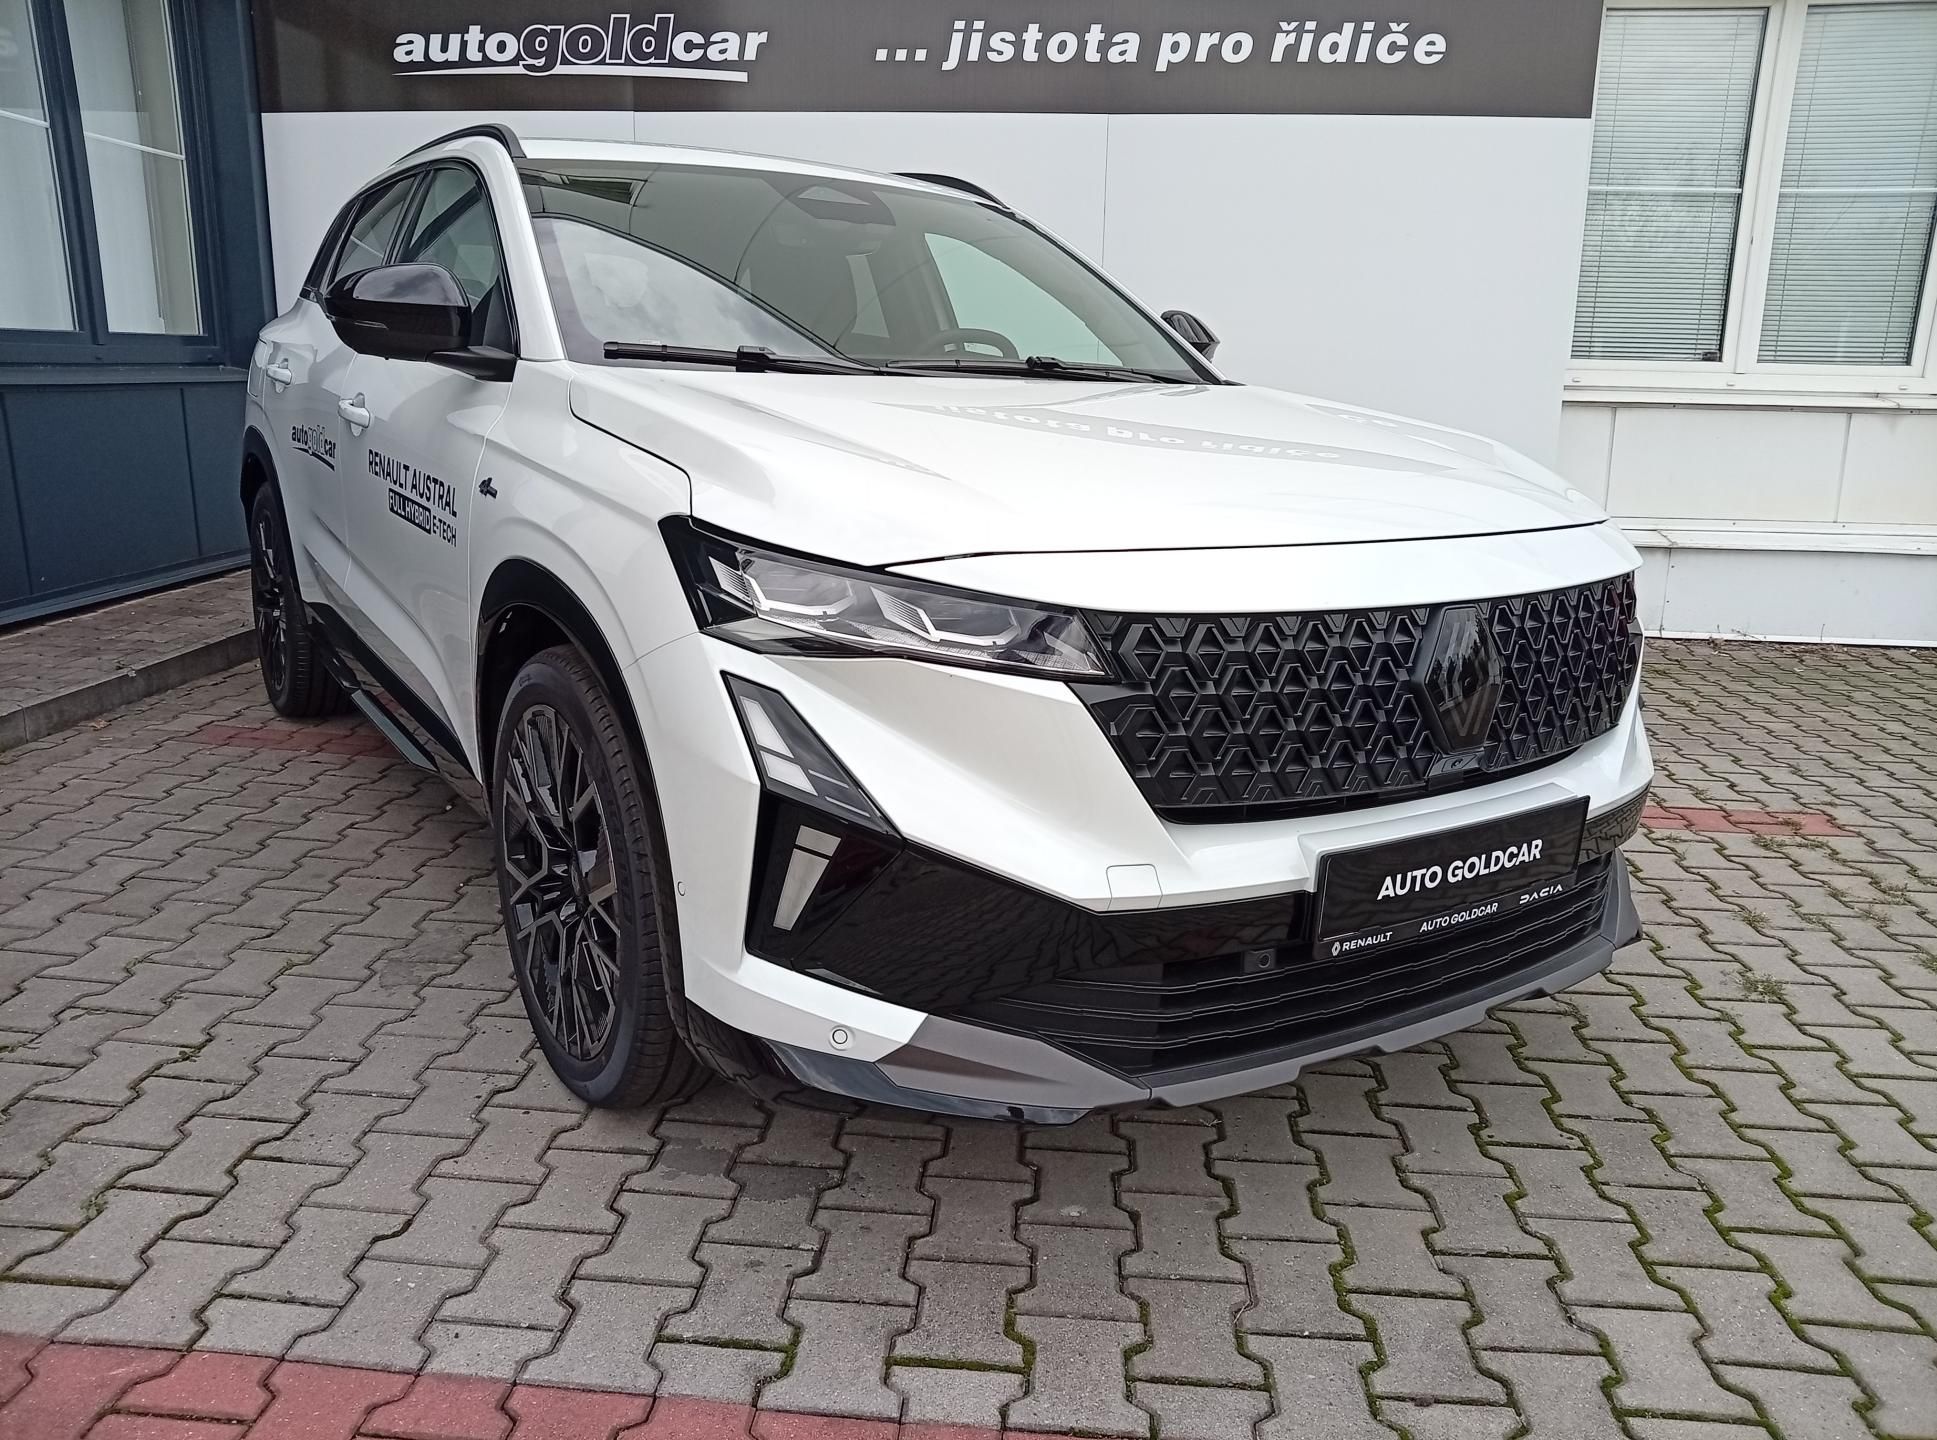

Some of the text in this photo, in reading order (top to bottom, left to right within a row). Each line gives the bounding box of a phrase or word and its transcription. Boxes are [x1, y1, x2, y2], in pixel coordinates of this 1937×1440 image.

[393, 13, 768, 76] autogoldcar
[941, 20, 1140, 70] jistota
[1154, 30, 1254, 72] pro
[1270, 21, 1447, 65] řidiče
[368, 449, 410, 491] RENAULT
[410, 468, 457, 518] AUSTRAL
[389, 492, 457, 548] FULL HYBRID E-TECH
[1376, 838, 1543, 900] AUTO GOLDCAR
[1519, 884, 1563, 905] DACIA
[1342, 931, 1393, 951] RENAULT
[1419, 902, 1499, 933] AUTO GOLDCAR
